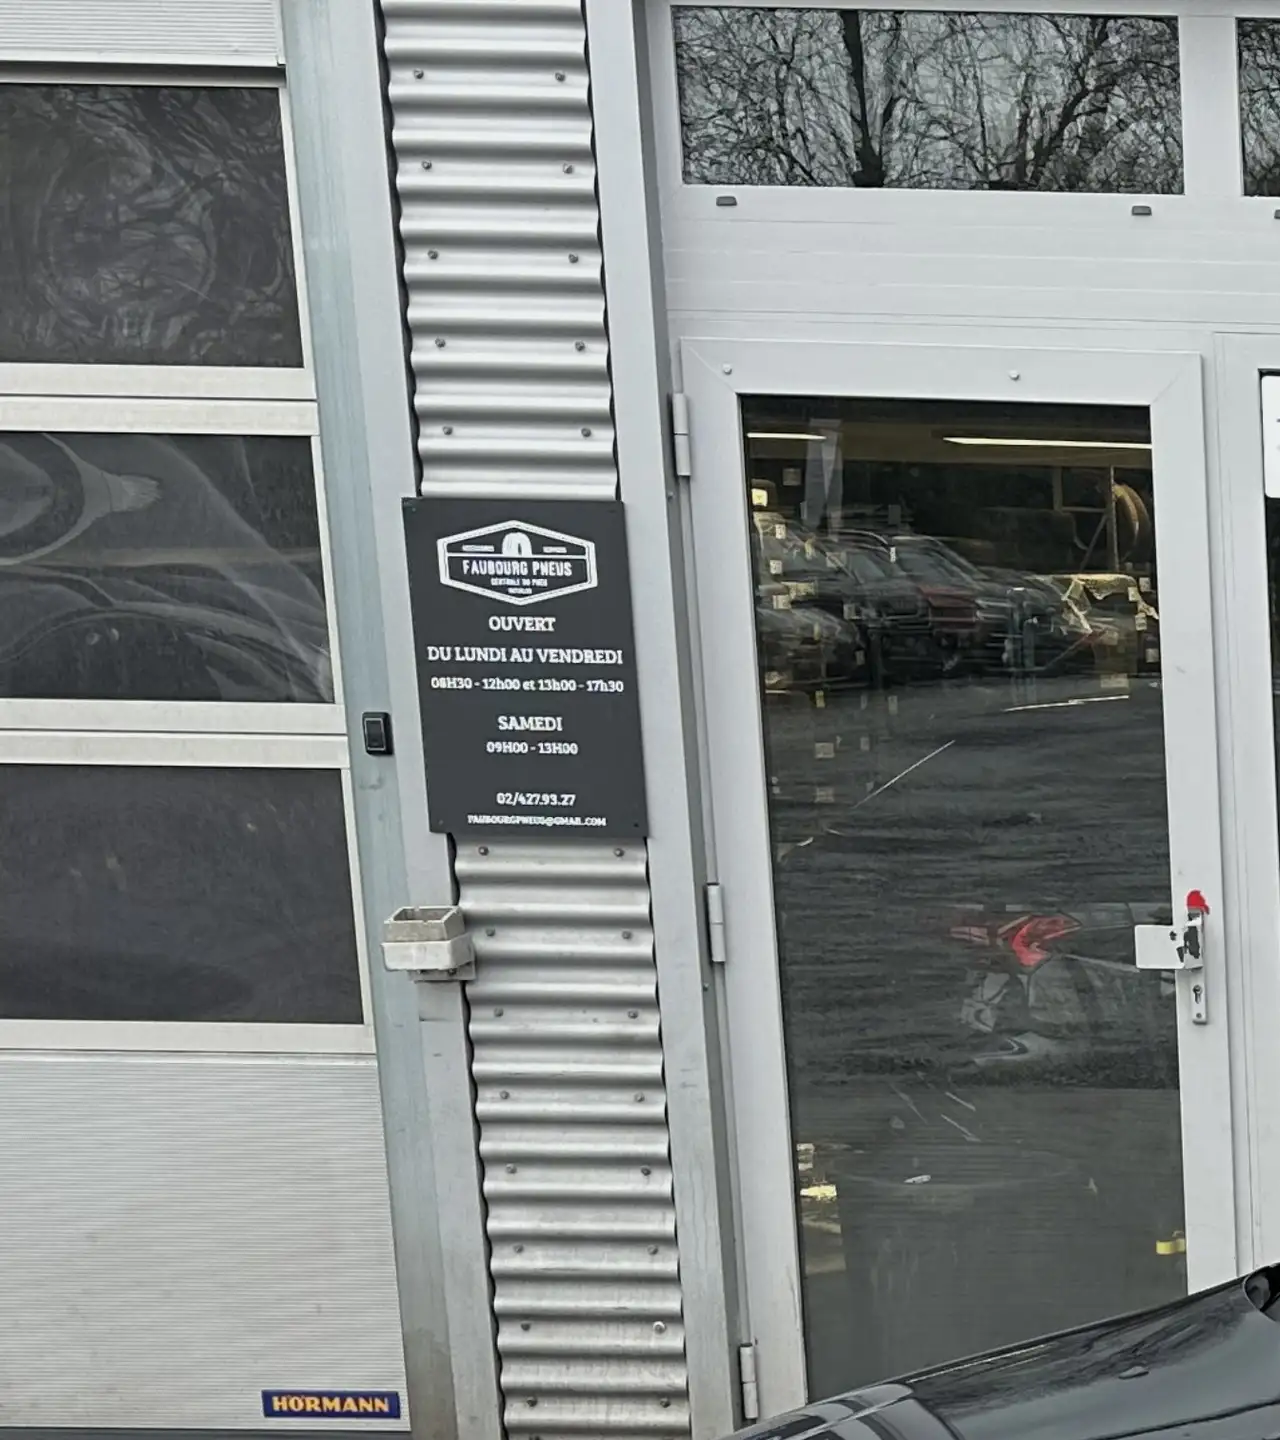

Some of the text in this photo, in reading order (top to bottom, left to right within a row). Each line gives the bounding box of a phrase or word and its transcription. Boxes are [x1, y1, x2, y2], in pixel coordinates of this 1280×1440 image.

[462, 559, 573, 578] FAUBOURG PNEUS
[488, 616, 556, 632] OUVERT
[427, 646, 624, 665] DU LUNDI AU VENDREDI
[482, 677, 520, 691] 12h00
[522, 678, 536, 691] et
[537, 678, 577, 692] 13h00
[586, 679, 624, 693] 17h30
[497, 715, 563, 732] SAMEDI
[486, 741, 528, 755] 09H00
[538, 741, 579, 756] 13H00
